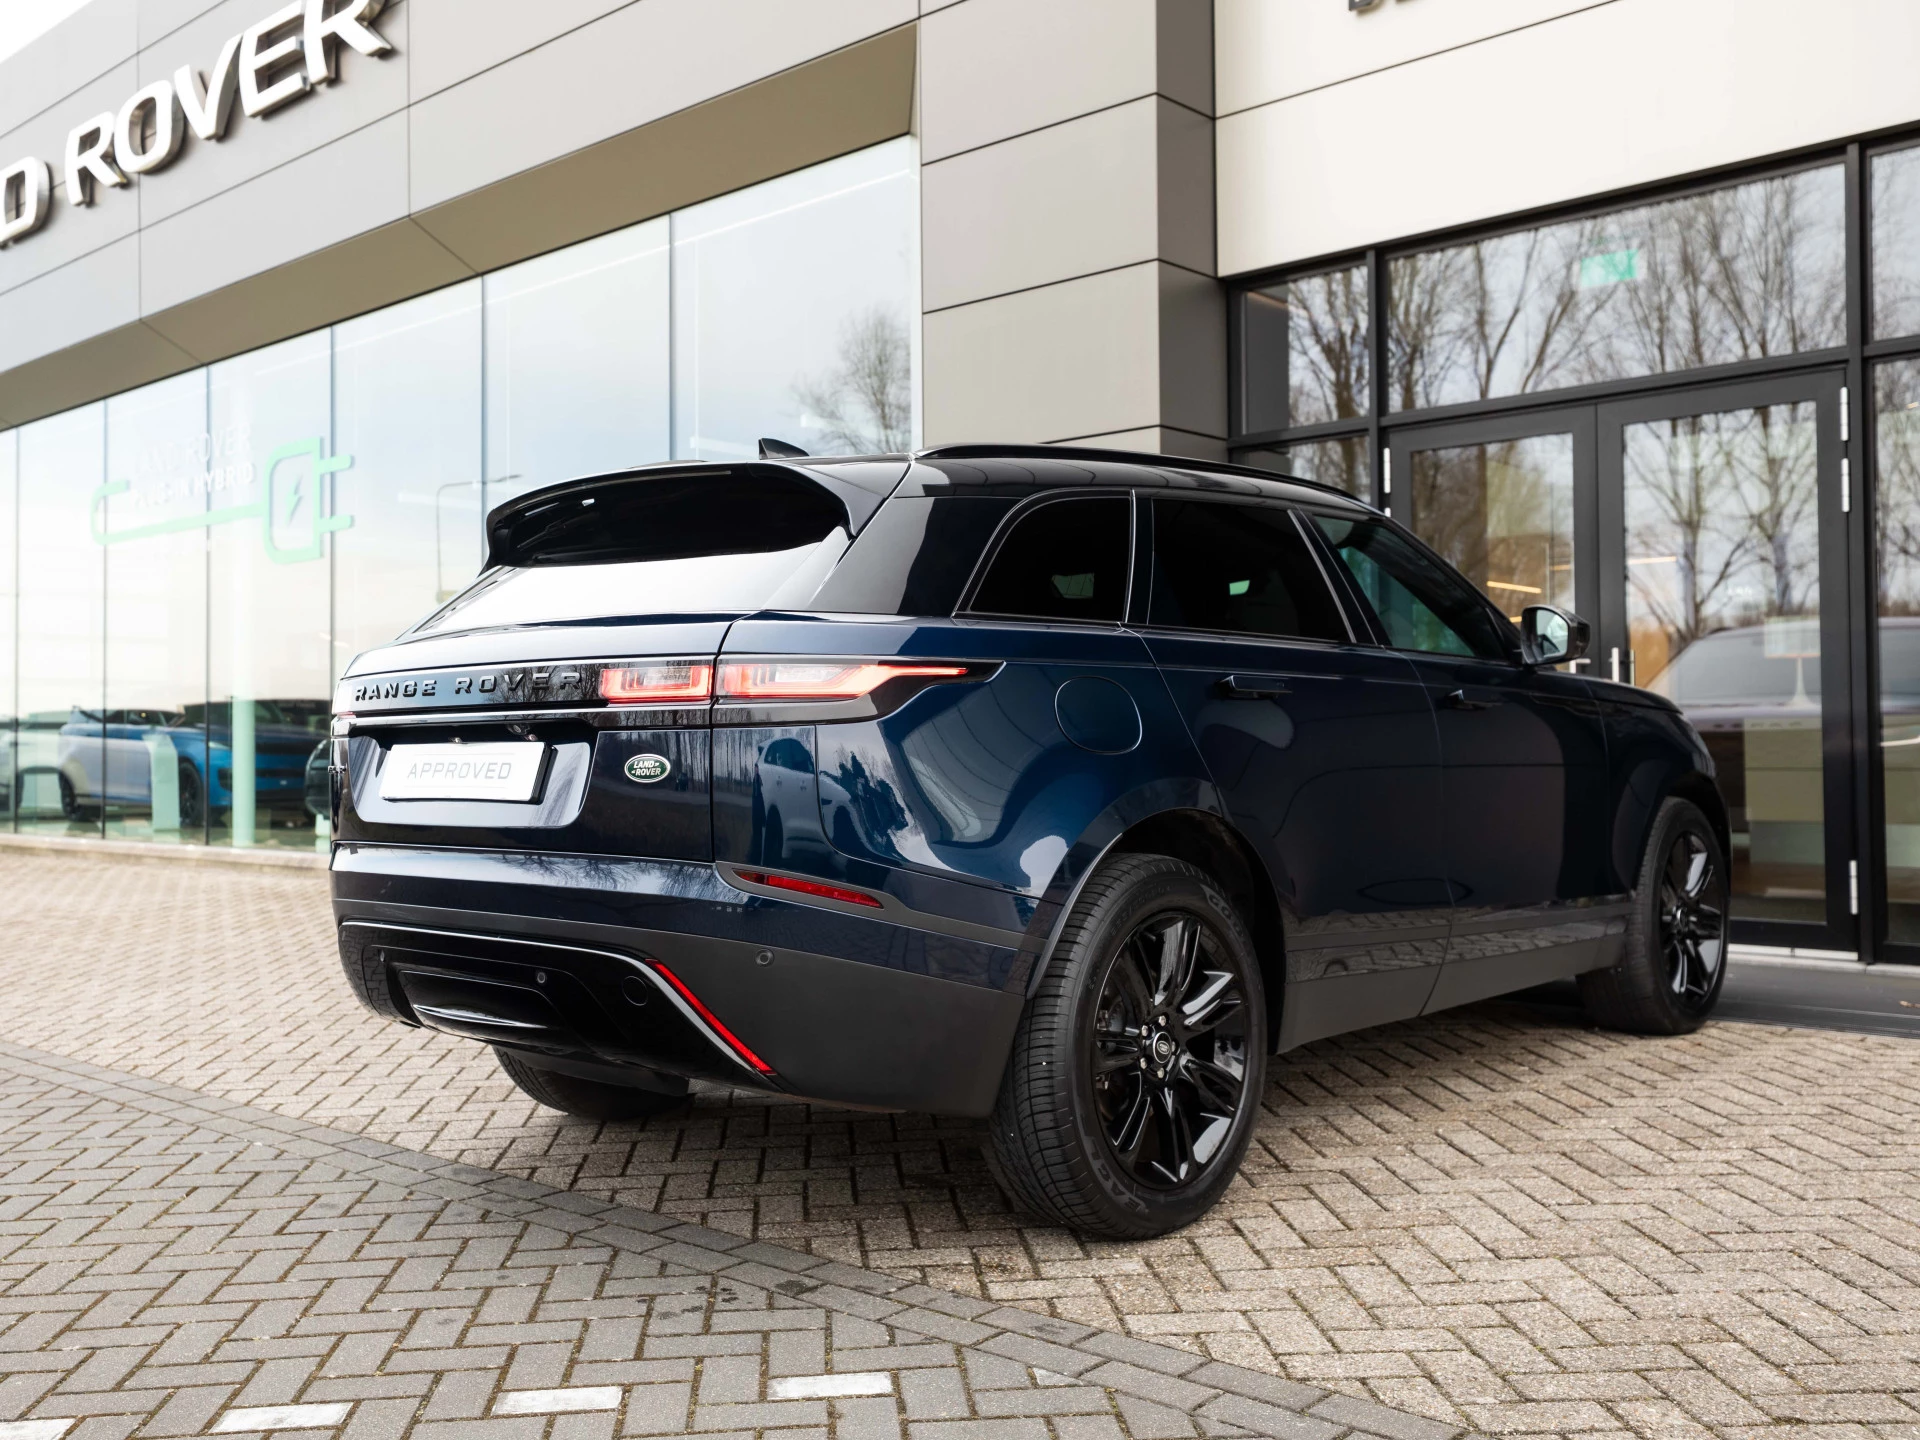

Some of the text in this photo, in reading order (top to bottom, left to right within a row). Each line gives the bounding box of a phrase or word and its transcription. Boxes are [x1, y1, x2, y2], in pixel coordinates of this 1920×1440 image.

[64, 0, 392, 207] ROVER
[355, 672, 582, 702] RANGE ROVER
[407, 761, 512, 780] APPROVED
[633, 760, 655, 769] LAND
[635, 768, 661, 776] ROVER
